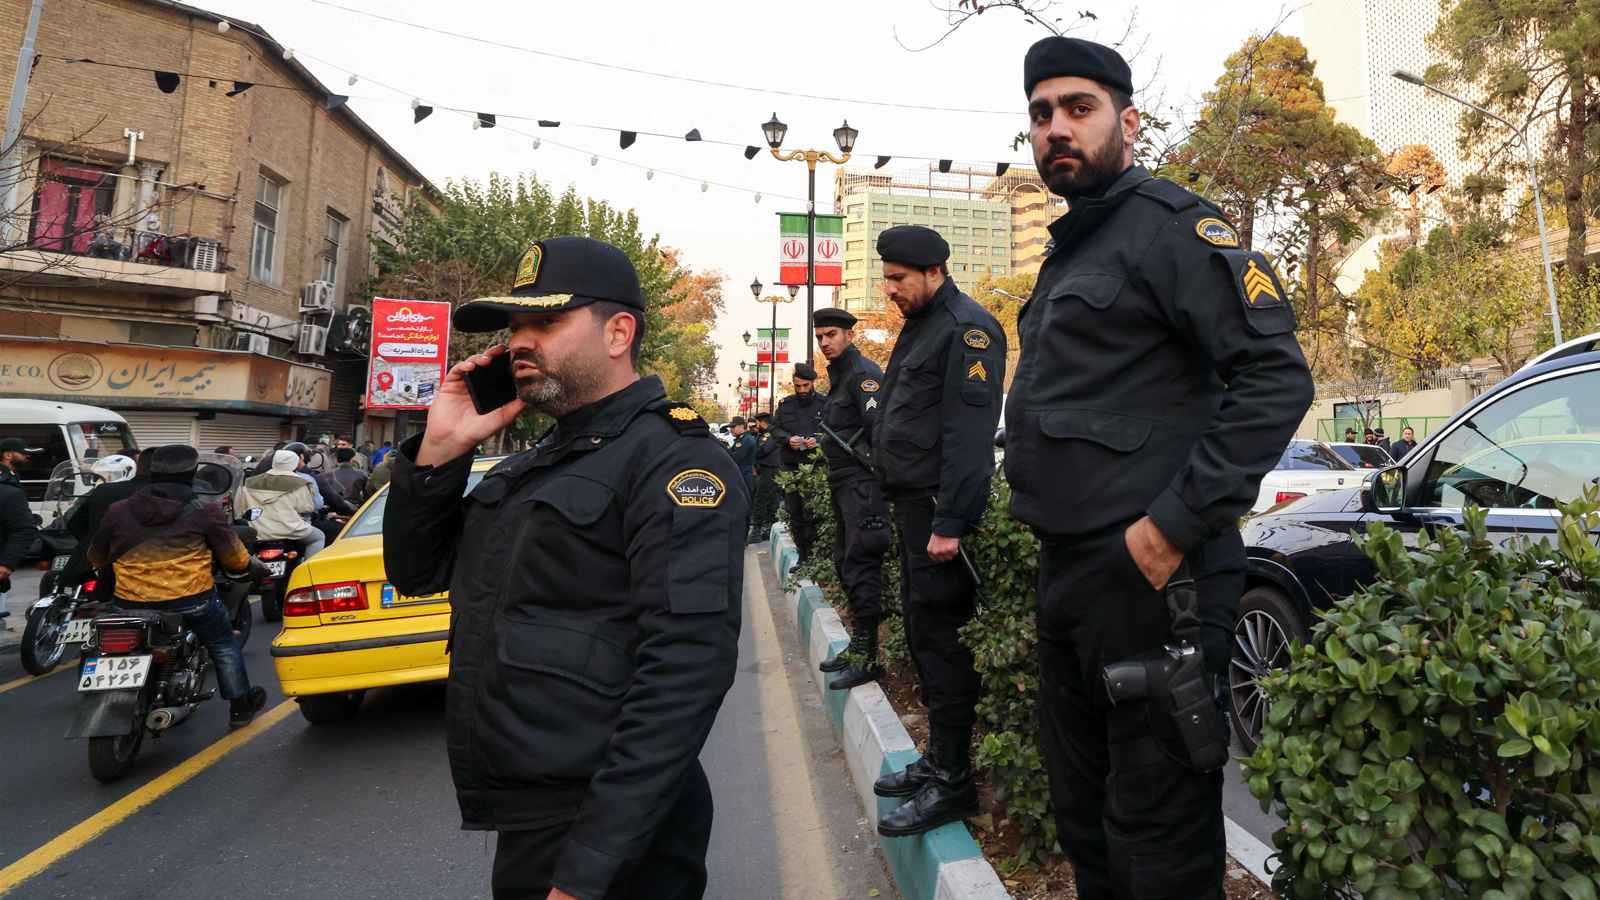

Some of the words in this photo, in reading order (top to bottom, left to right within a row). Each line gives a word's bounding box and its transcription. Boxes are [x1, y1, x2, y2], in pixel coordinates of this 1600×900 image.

[16, 364, 44, 377] CO.
[107, 360, 176, 389] ایران
[178, 364, 216, 390] بیمه
[677, 485, 699, 493] امداد
[700, 486, 716, 496] یگان
[681, 496, 714, 504] POLICE
[108, 657, 140, 671] ۱۵۶
